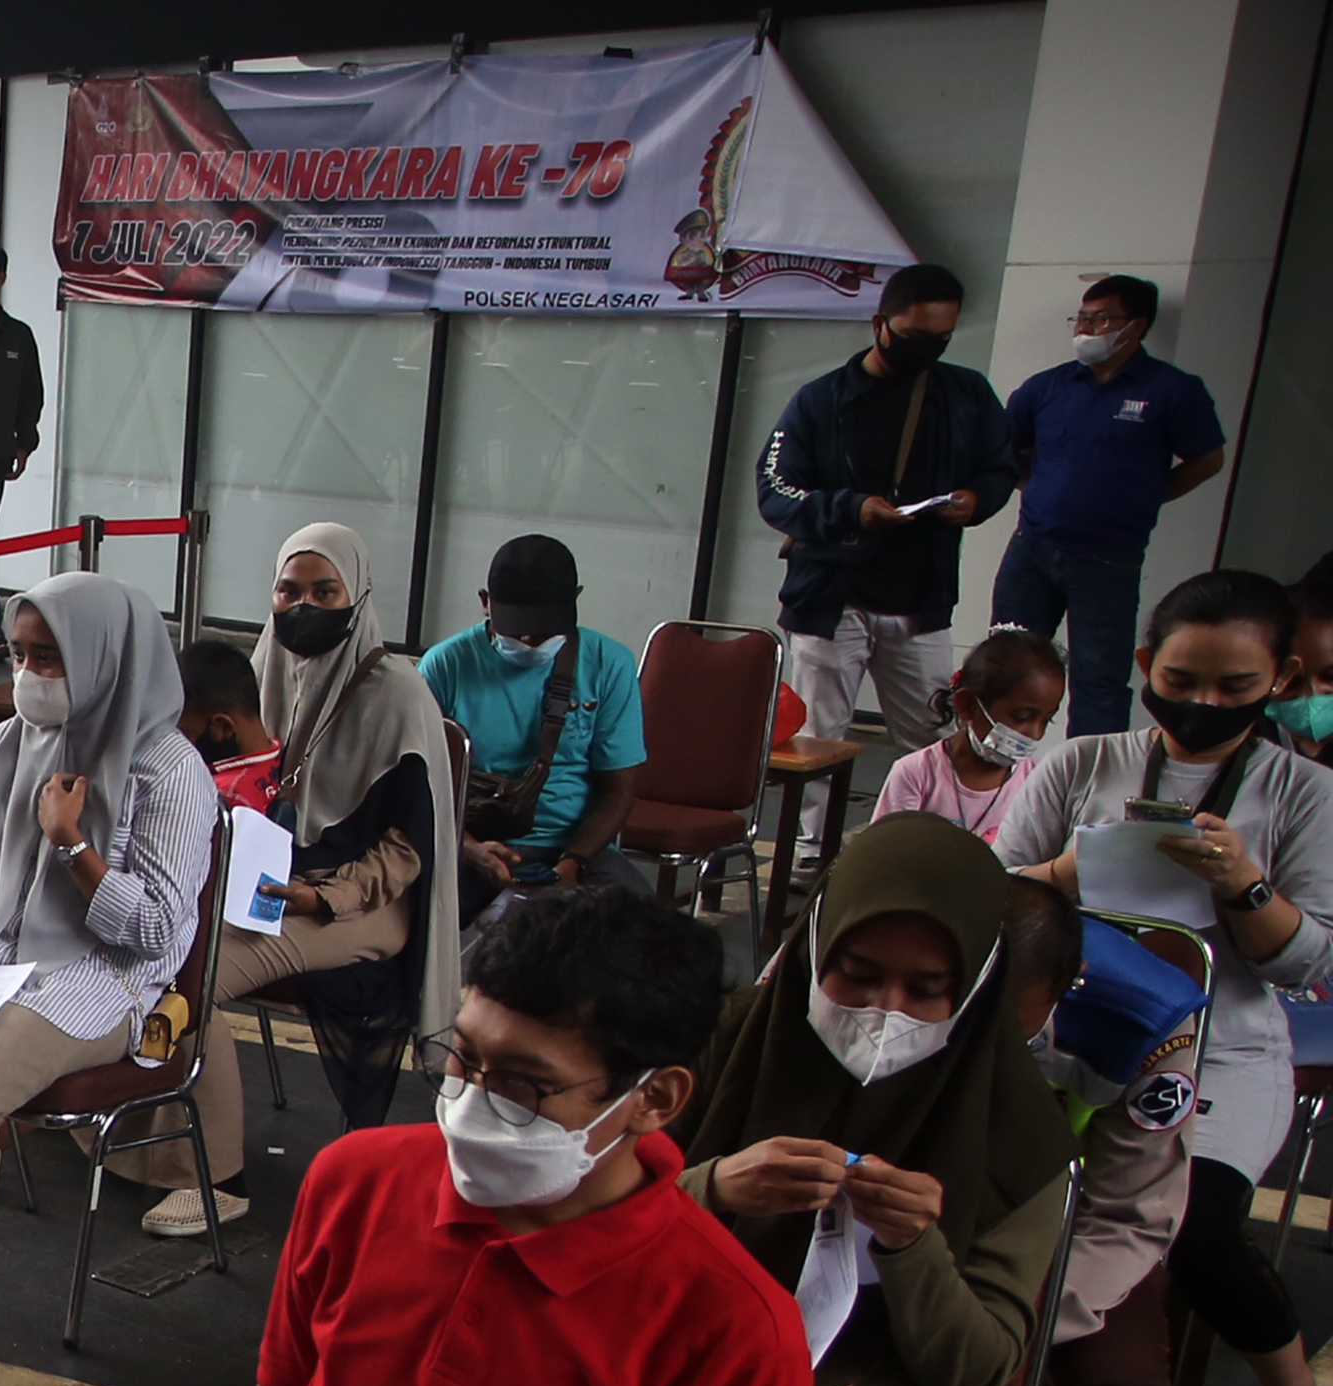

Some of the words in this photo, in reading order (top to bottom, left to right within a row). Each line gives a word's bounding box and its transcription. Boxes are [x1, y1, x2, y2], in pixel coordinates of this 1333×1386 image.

[95, 121, 117, 134] G20
[80, 151, 170, 202] HARI
[165, 145, 463, 202] BHAYANGKARA
[466, 143, 540, 199] KE
[344, 215, 385, 229] PRESISI
[71, 221, 94, 261] 1
[90, 219, 165, 265] JULI
[162, 218, 257, 267] 2022
[403, 236, 451, 249] EKONOMI
[451, 236, 474, 249] DAN
[475, 236, 535, 249] REFORMASI
[537, 236, 612, 249] STRUKTURAL
[381, 255, 442, 269] INDONESIA
[443, 257, 493, 270] TANGGUH
[503, 257, 561, 270] INDONESIA
[565, 257, 612, 270] TUMBUH
[464, 291, 539, 308] POLSEK
[542, 292, 660, 309] NEGLASARI
